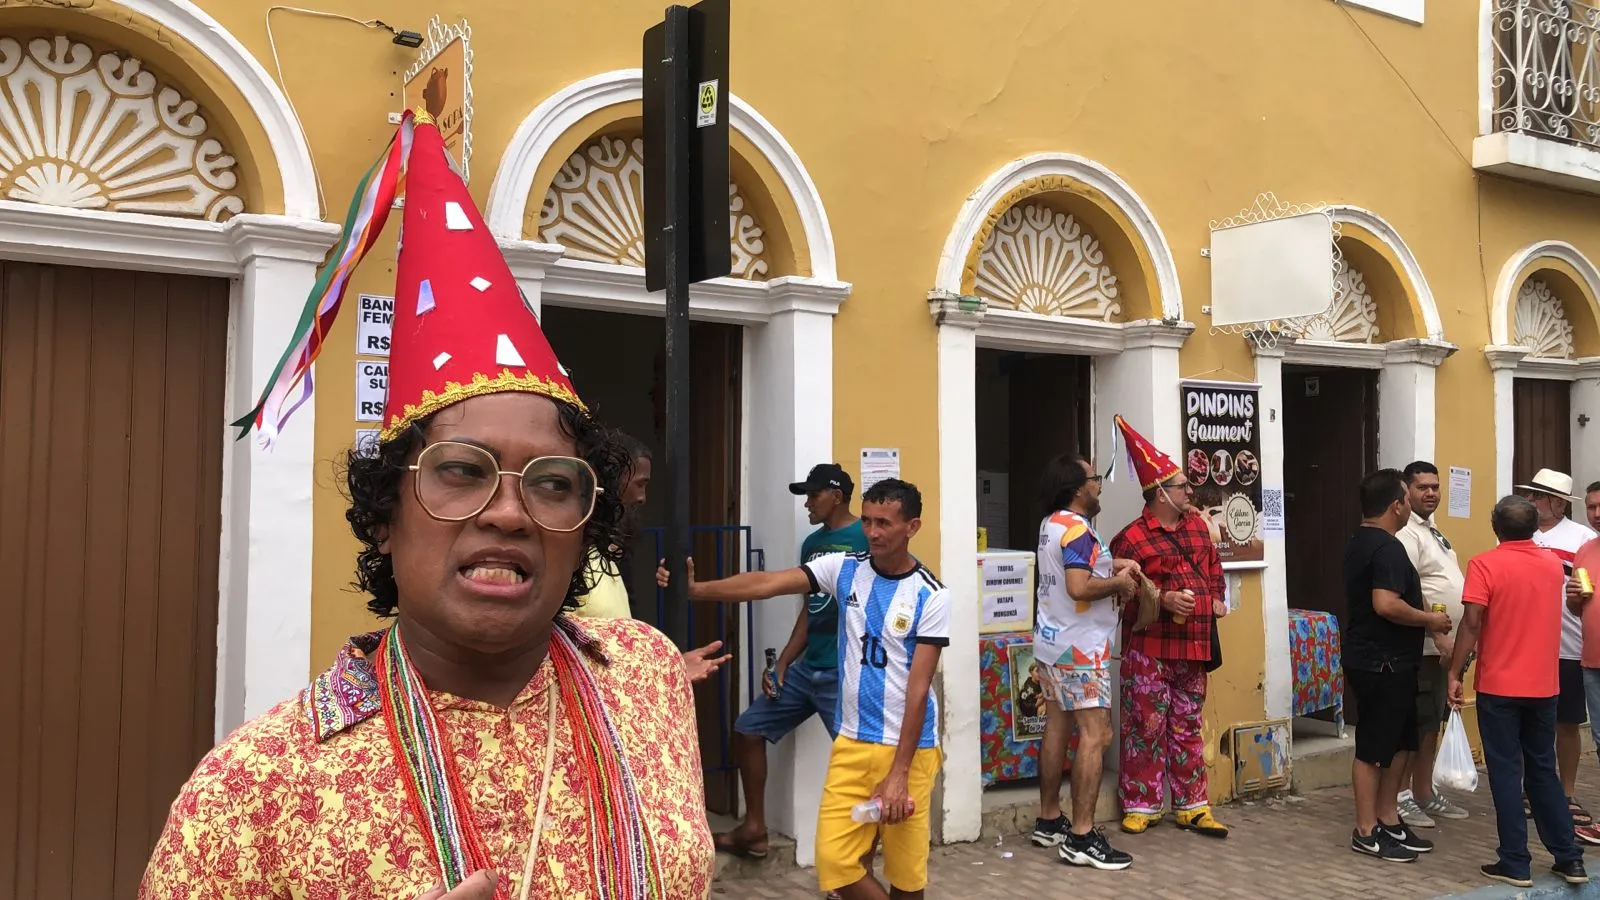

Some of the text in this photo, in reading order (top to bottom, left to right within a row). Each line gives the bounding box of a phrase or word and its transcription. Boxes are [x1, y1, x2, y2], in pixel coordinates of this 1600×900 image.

[362, 298, 393, 311] BAN
[363, 312, 393, 324] FEM
[1187, 391, 1254, 418] DINDINS
[1086, 846, 1106, 861] FILA
